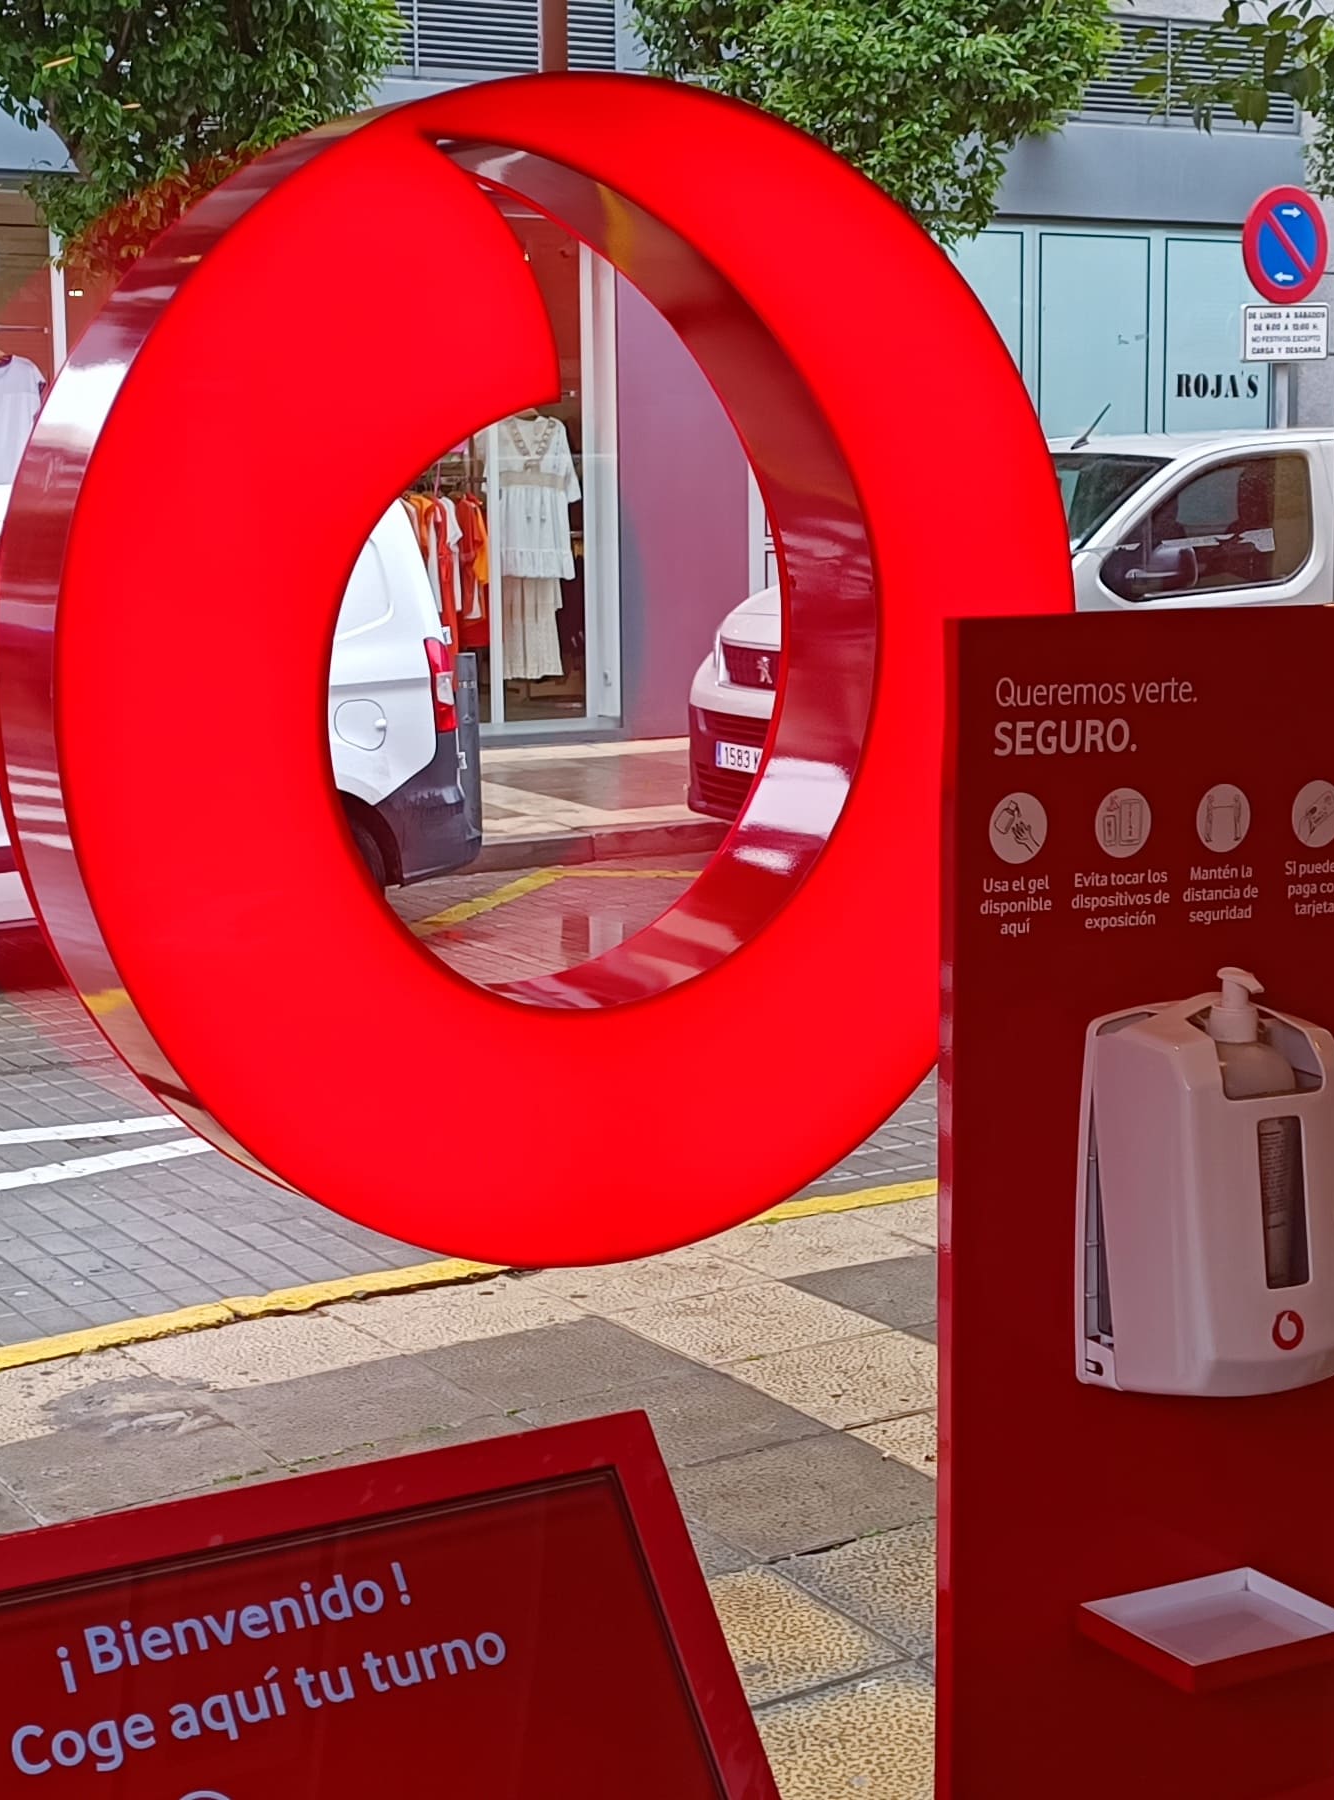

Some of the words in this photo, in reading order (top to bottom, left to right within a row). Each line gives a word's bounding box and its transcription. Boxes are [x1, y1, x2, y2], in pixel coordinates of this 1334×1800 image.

[1176, 371, 1259, 398] ROJA'S
[995, 677, 1127, 707] Queremos
[1131, 677, 1198, 703] verte.
[994, 718, 1138, 756] SEGURO.
[724, 746, 751, 769] 1583
[1074, 872, 1108, 888] Evita
[1110, 871, 1145, 886] tocar
[1147, 869, 1168, 884] los
[1190, 864, 1238, 881] Mantén
[1241, 864, 1253, 878] la
[983, 878, 1009, 893] Usa
[1012, 877, 1025, 892] el
[1028, 875, 1050, 894] gel
[1183, 885, 1241, 902] distancia
[1243, 884, 1259, 898] de
[1287, 883, 1317, 899] paga
[980, 897, 1052, 917] disponible
[1071, 892, 1152, 911] dispositivos
[1154, 889, 1170, 905] de
[1295, 901, 1334, 918] tarjeta
[1085, 910, 1156, 932] exposición
[1189, 905, 1252, 925] seguridad
[1000, 917, 1031, 937] aquí
[83, 1574, 384, 1675] Bienvenido
[11, 1713, 156, 1776] Coge
[169, 1666, 286, 1741] aquí
[294, 1666, 355, 1709] tu
[362, 1632, 506, 1692] turno
